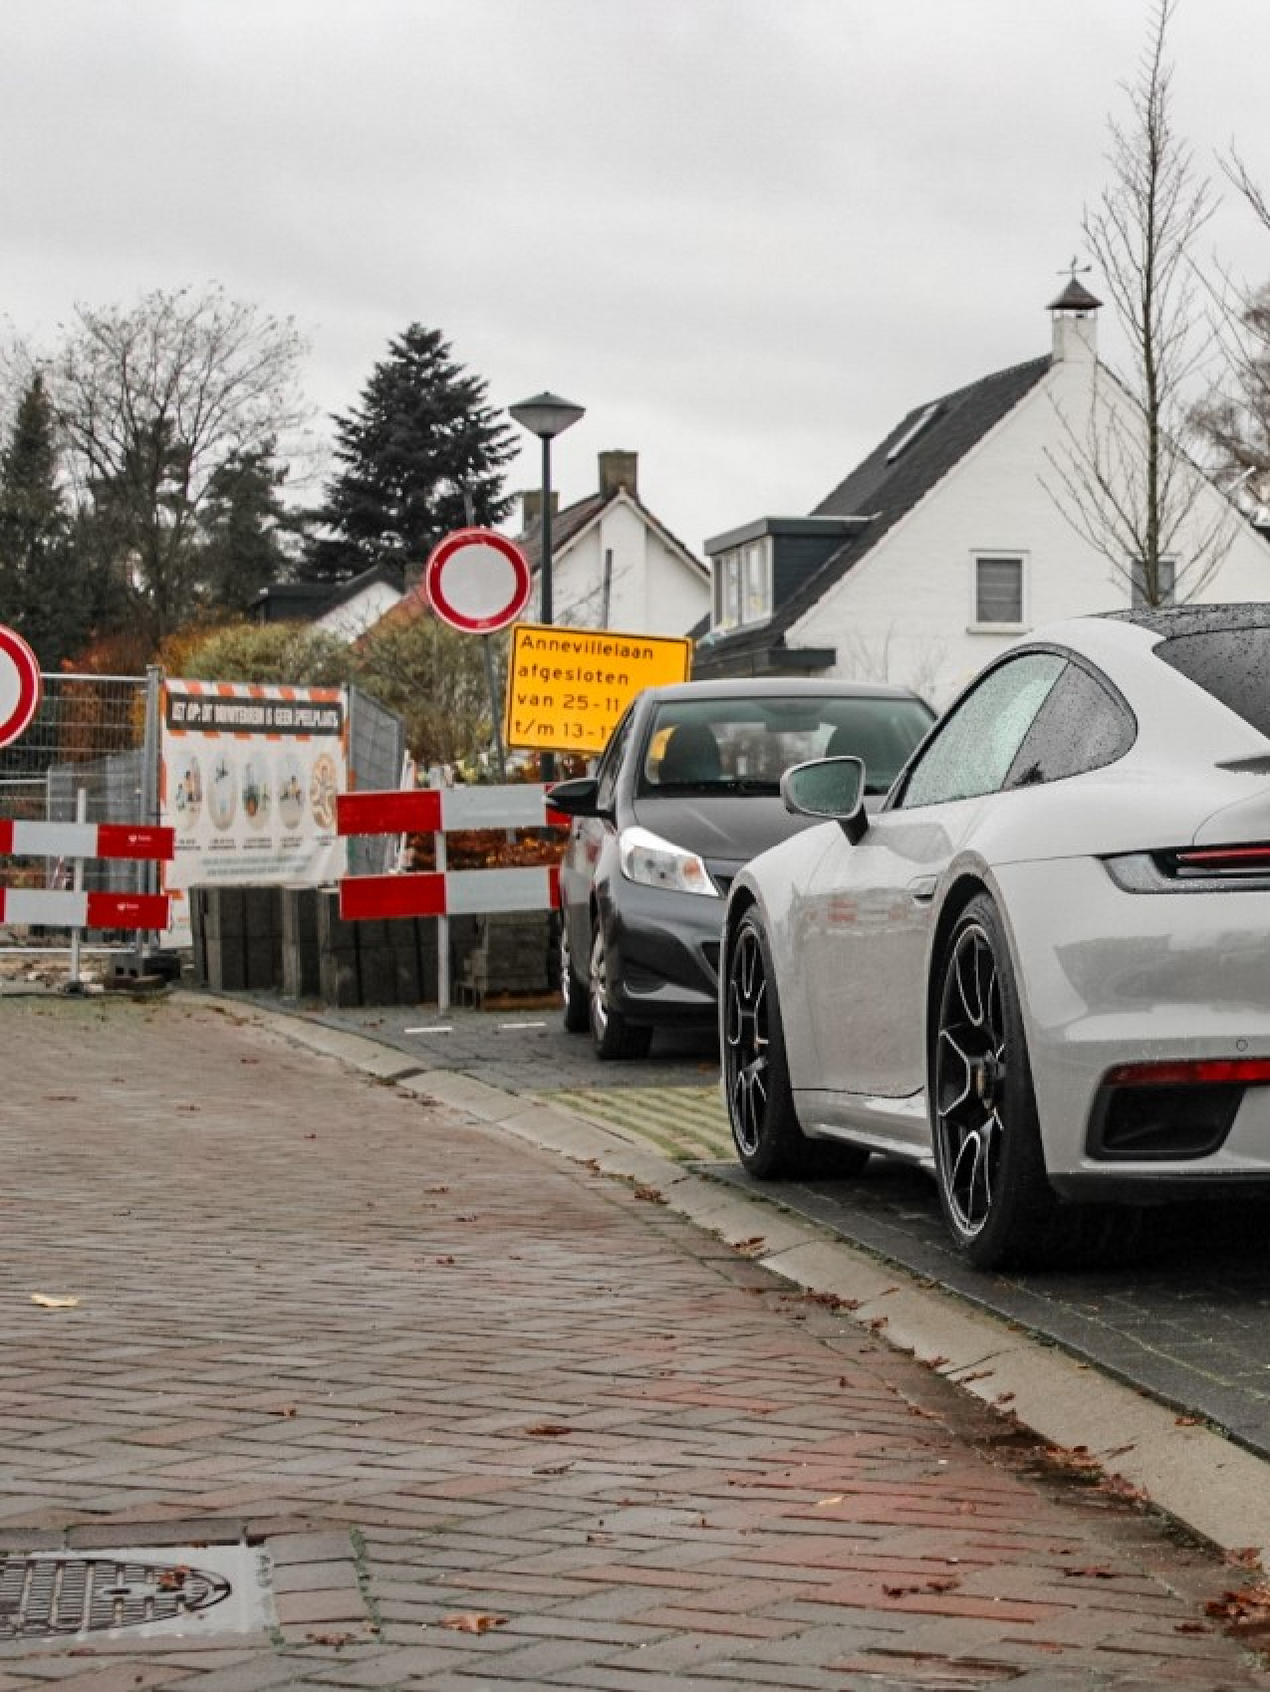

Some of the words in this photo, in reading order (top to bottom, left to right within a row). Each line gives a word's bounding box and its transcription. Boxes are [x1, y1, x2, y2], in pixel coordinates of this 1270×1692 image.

[521, 635, 654, 660] Annevillelaan
[517, 663, 629, 685] afgesloten
[517, 694, 554, 707] van
[563, 694, 619, 712] 25-11
[515, 719, 555, 736] t/m
[563, 722, 615, 740] 13-1
